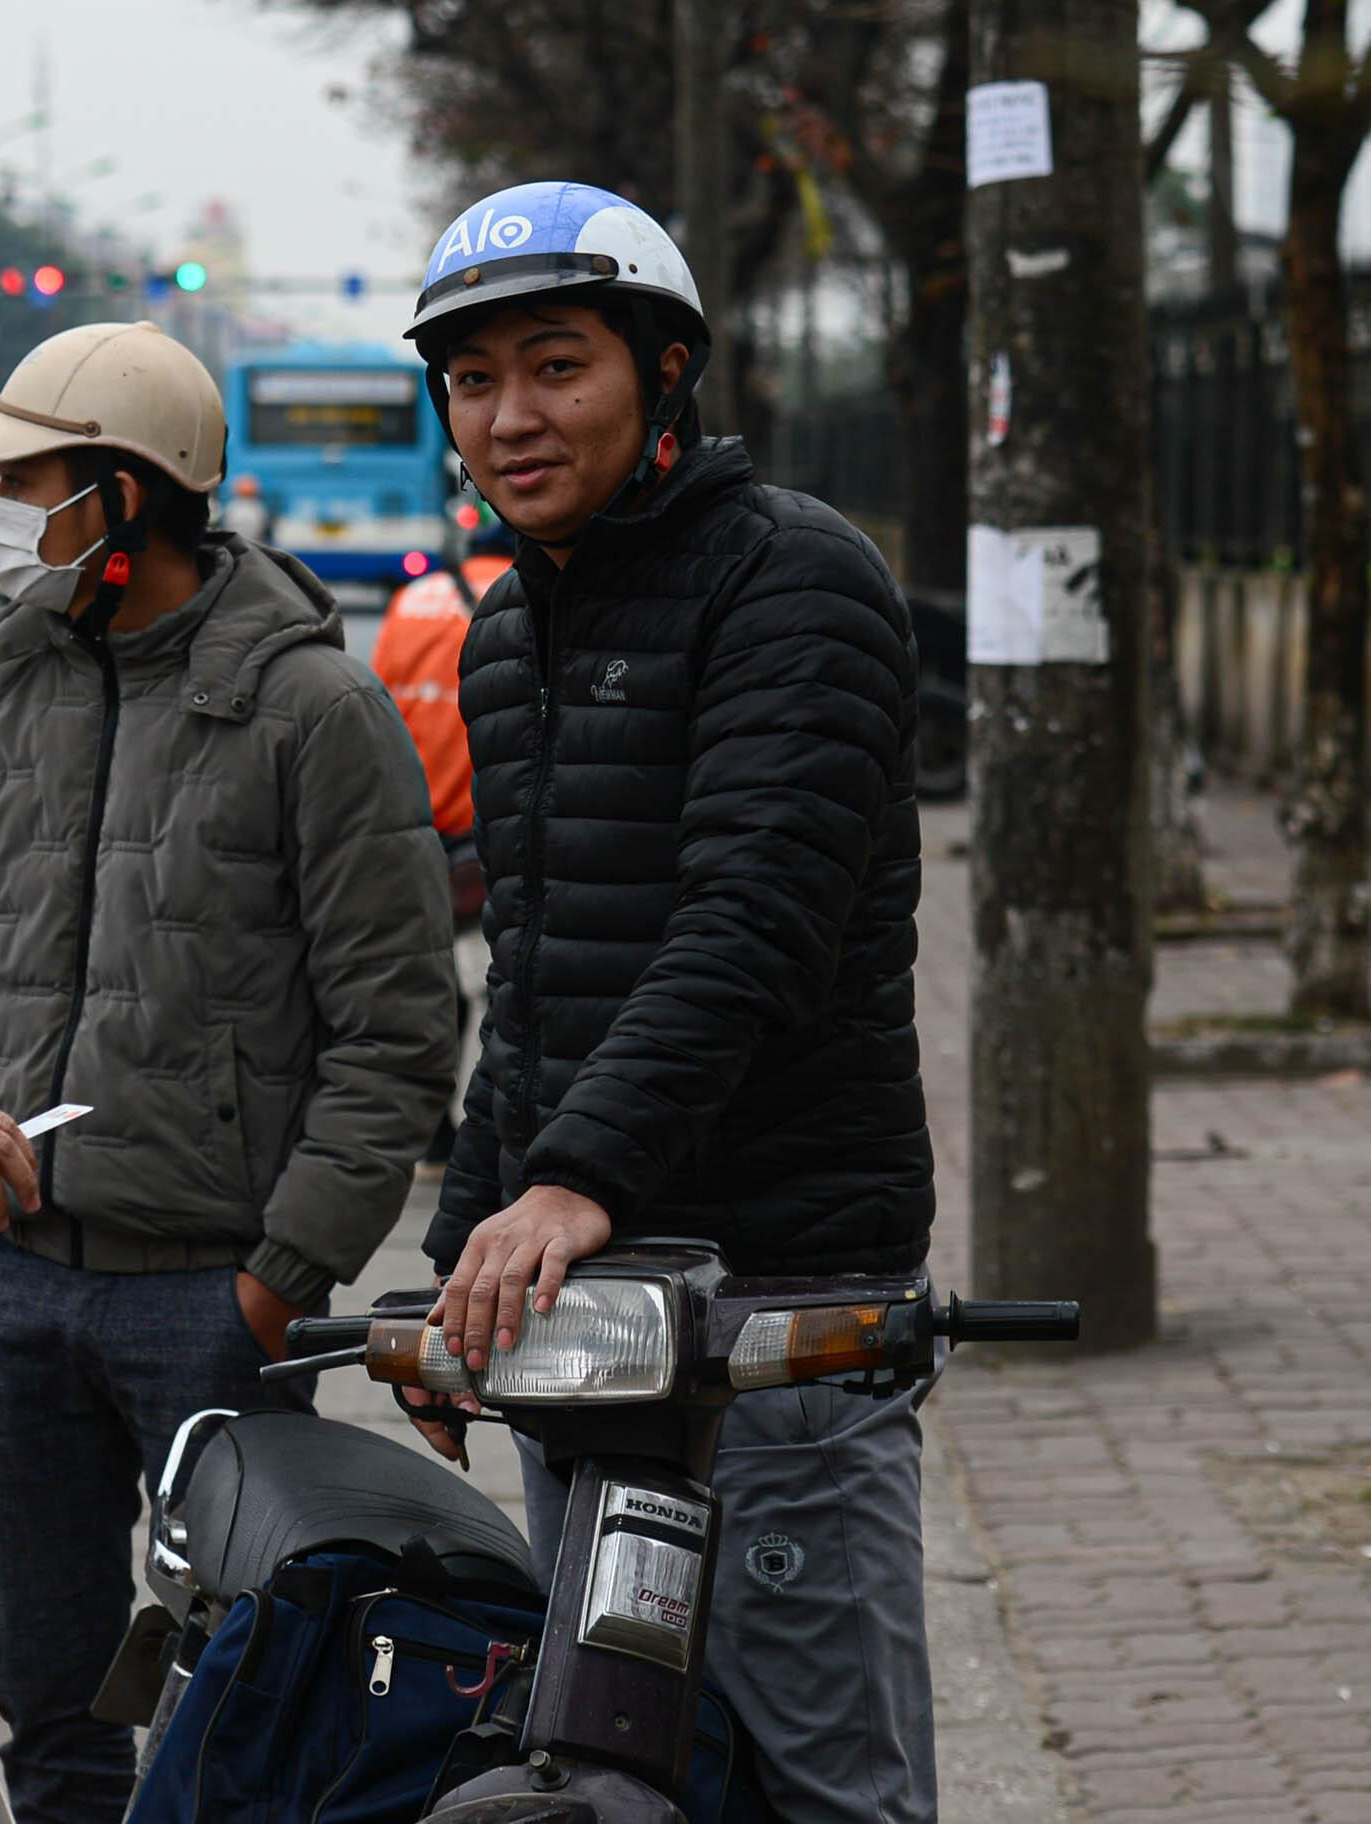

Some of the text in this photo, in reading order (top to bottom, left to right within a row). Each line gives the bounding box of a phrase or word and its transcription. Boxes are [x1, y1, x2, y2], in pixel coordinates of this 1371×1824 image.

[437, 208, 532, 274] Alo
[625, 1499, 703, 1530] HONDA
[638, 1588, 689, 1615] Dream
[661, 1609, 687, 1629] 100
